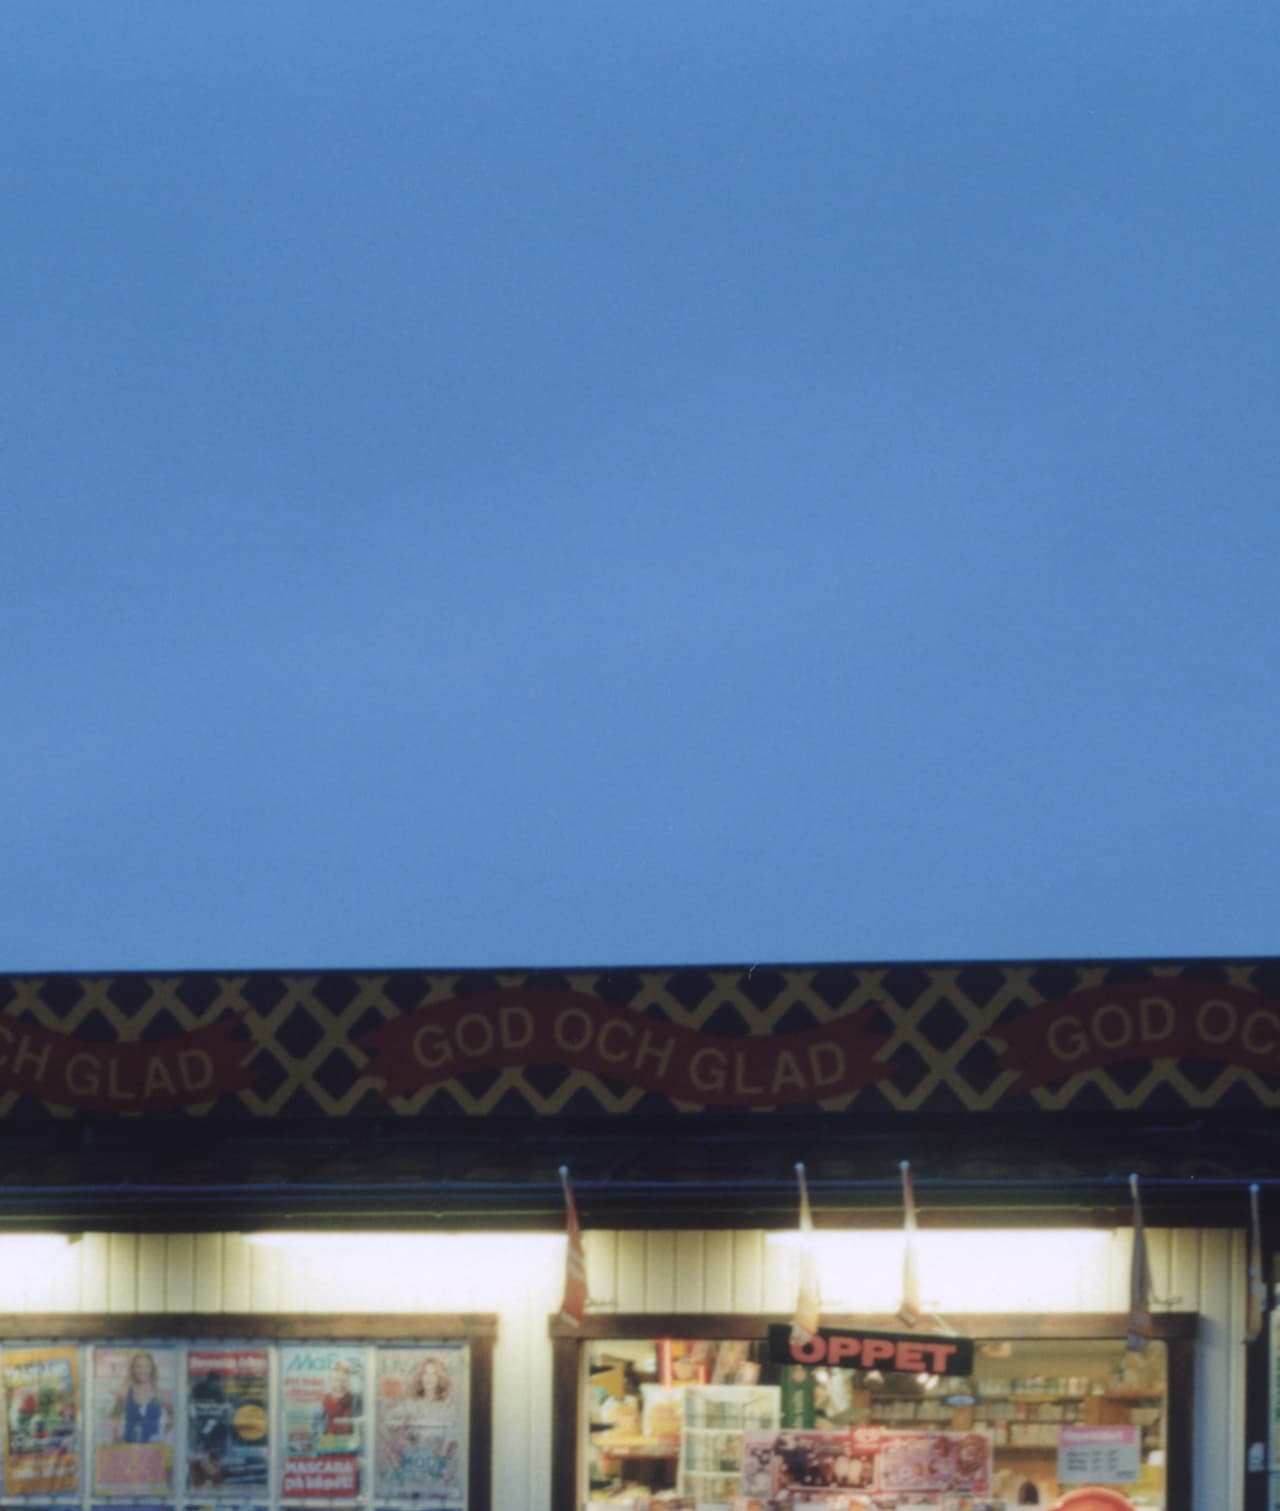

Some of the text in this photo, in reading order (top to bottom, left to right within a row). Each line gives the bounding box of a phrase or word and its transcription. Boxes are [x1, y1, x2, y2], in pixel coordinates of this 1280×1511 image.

[412, 1006, 847, 1096] GOD OCH GLAD
[1046, 997, 1177, 1061] GOD
[65, 1048, 215, 1100] GLAD
